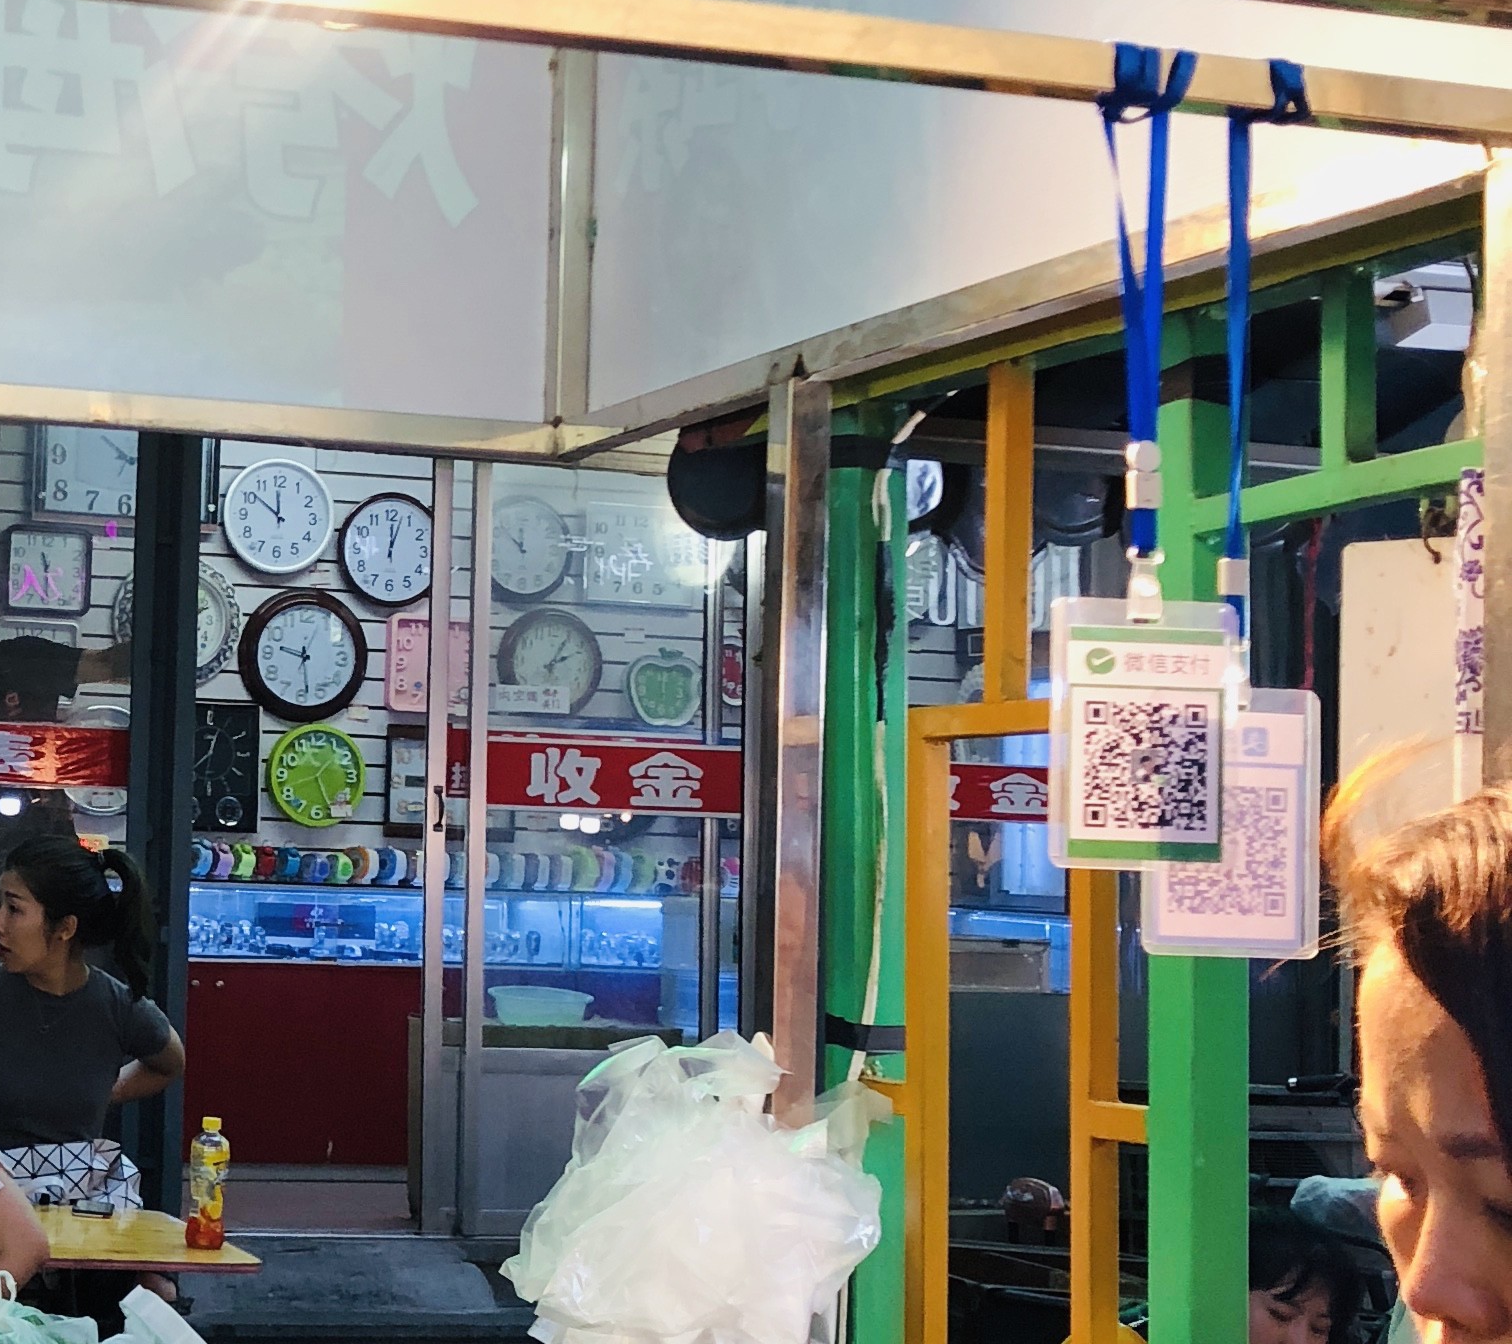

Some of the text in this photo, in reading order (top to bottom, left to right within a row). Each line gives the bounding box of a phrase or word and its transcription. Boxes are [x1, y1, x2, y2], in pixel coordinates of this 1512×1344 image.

[52, 443, 133, 514] 9 8 7 6
[239, 476, 317, 558] 12 11 1 10 2 9 3 8 4 7 5 6
[370, 514, 379, 526] 11
[385, 509, 398, 521] 12
[407, 515, 411, 527] 1
[358, 526, 369, 537] 10
[416, 529, 424, 541] 2
[420, 547, 428, 558] 3
[357, 560, 365, 572] 8
[415, 564, 422, 575] 4
[371, 574, 379, 586] 7
[385, 580, 393, 591] 6
[403, 576, 411, 588] 5
[1124, 652, 1210, 675] 微信支付
[277, 734, 357, 818] 12 11 1 2 10 9 3 8 7 6
[526, 746, 704, 808] 收金
